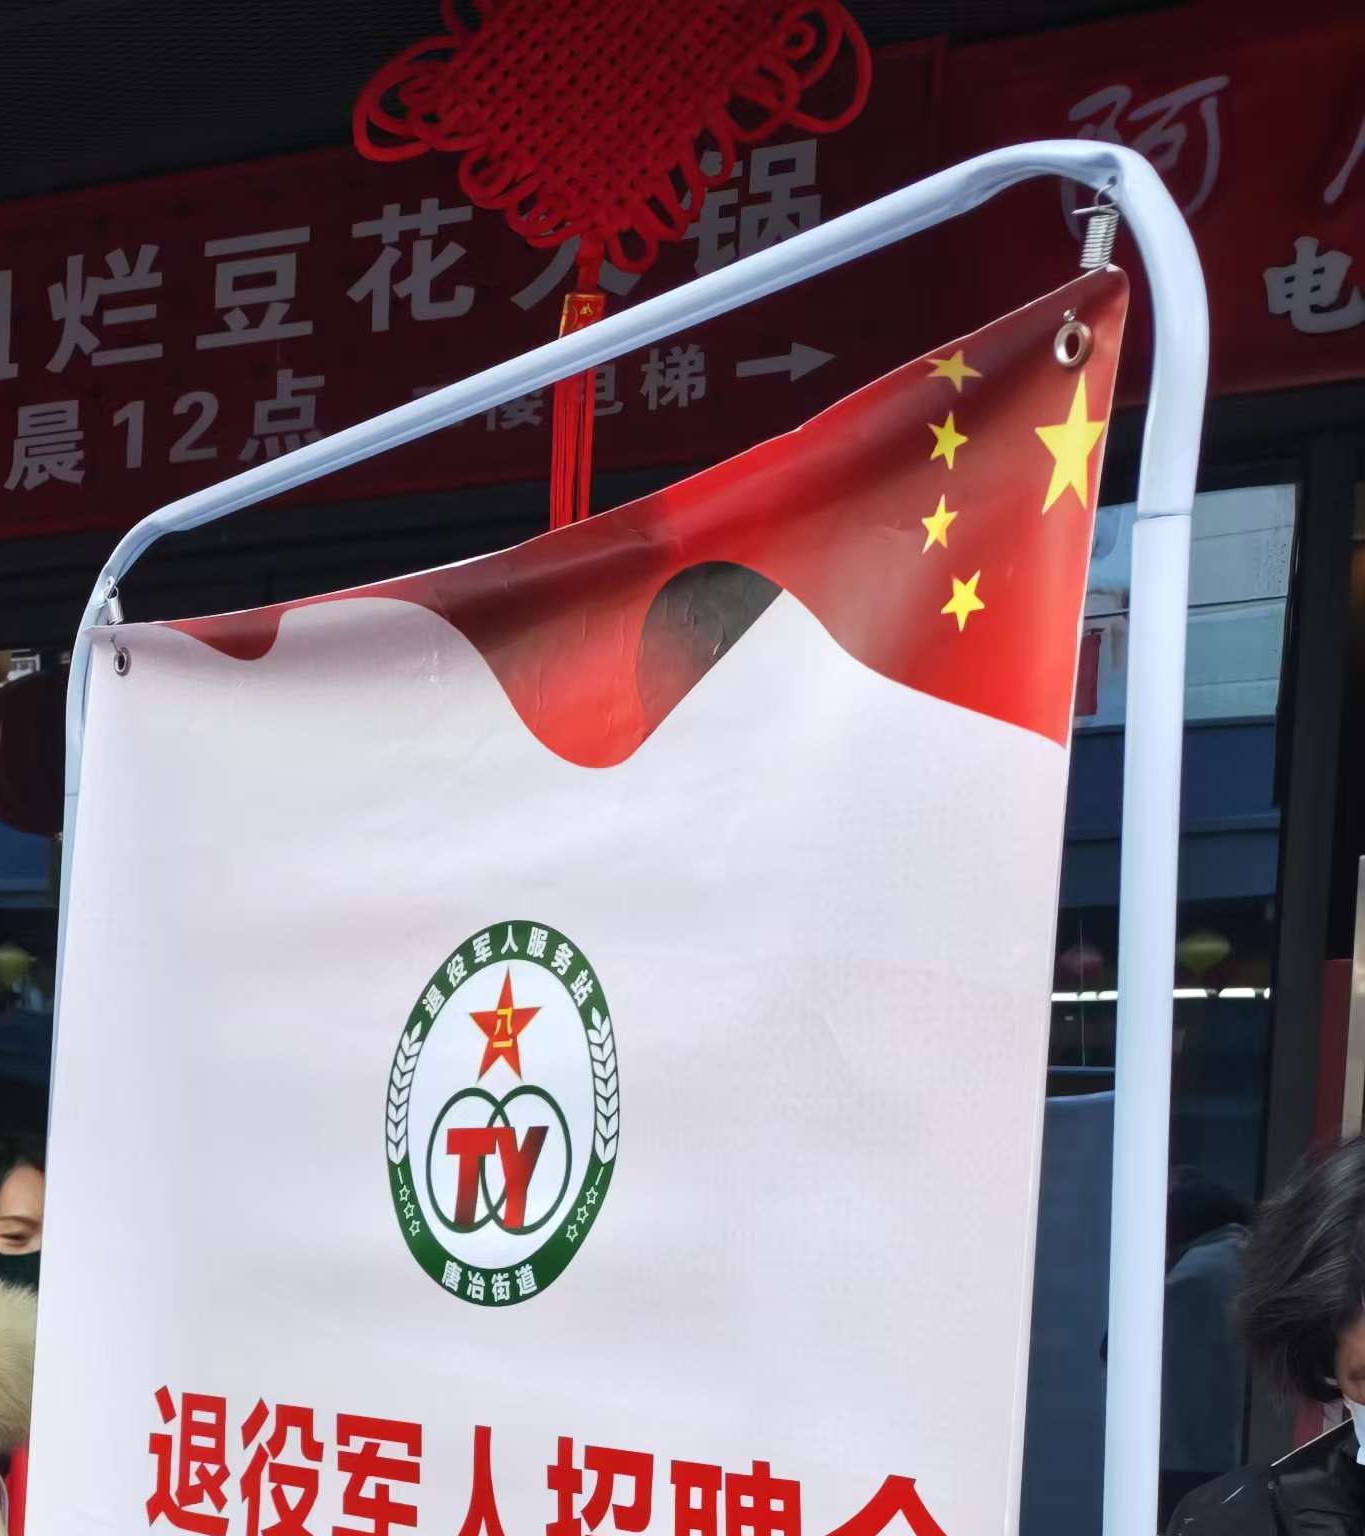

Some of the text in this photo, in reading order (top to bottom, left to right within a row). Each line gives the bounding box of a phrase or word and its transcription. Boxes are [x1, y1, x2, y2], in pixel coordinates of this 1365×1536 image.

[421, 924, 596, 1020] 退役军人服务站
[446, 1125, 550, 1230] TY
[441, 1259, 539, 1304] 唐冶街道
